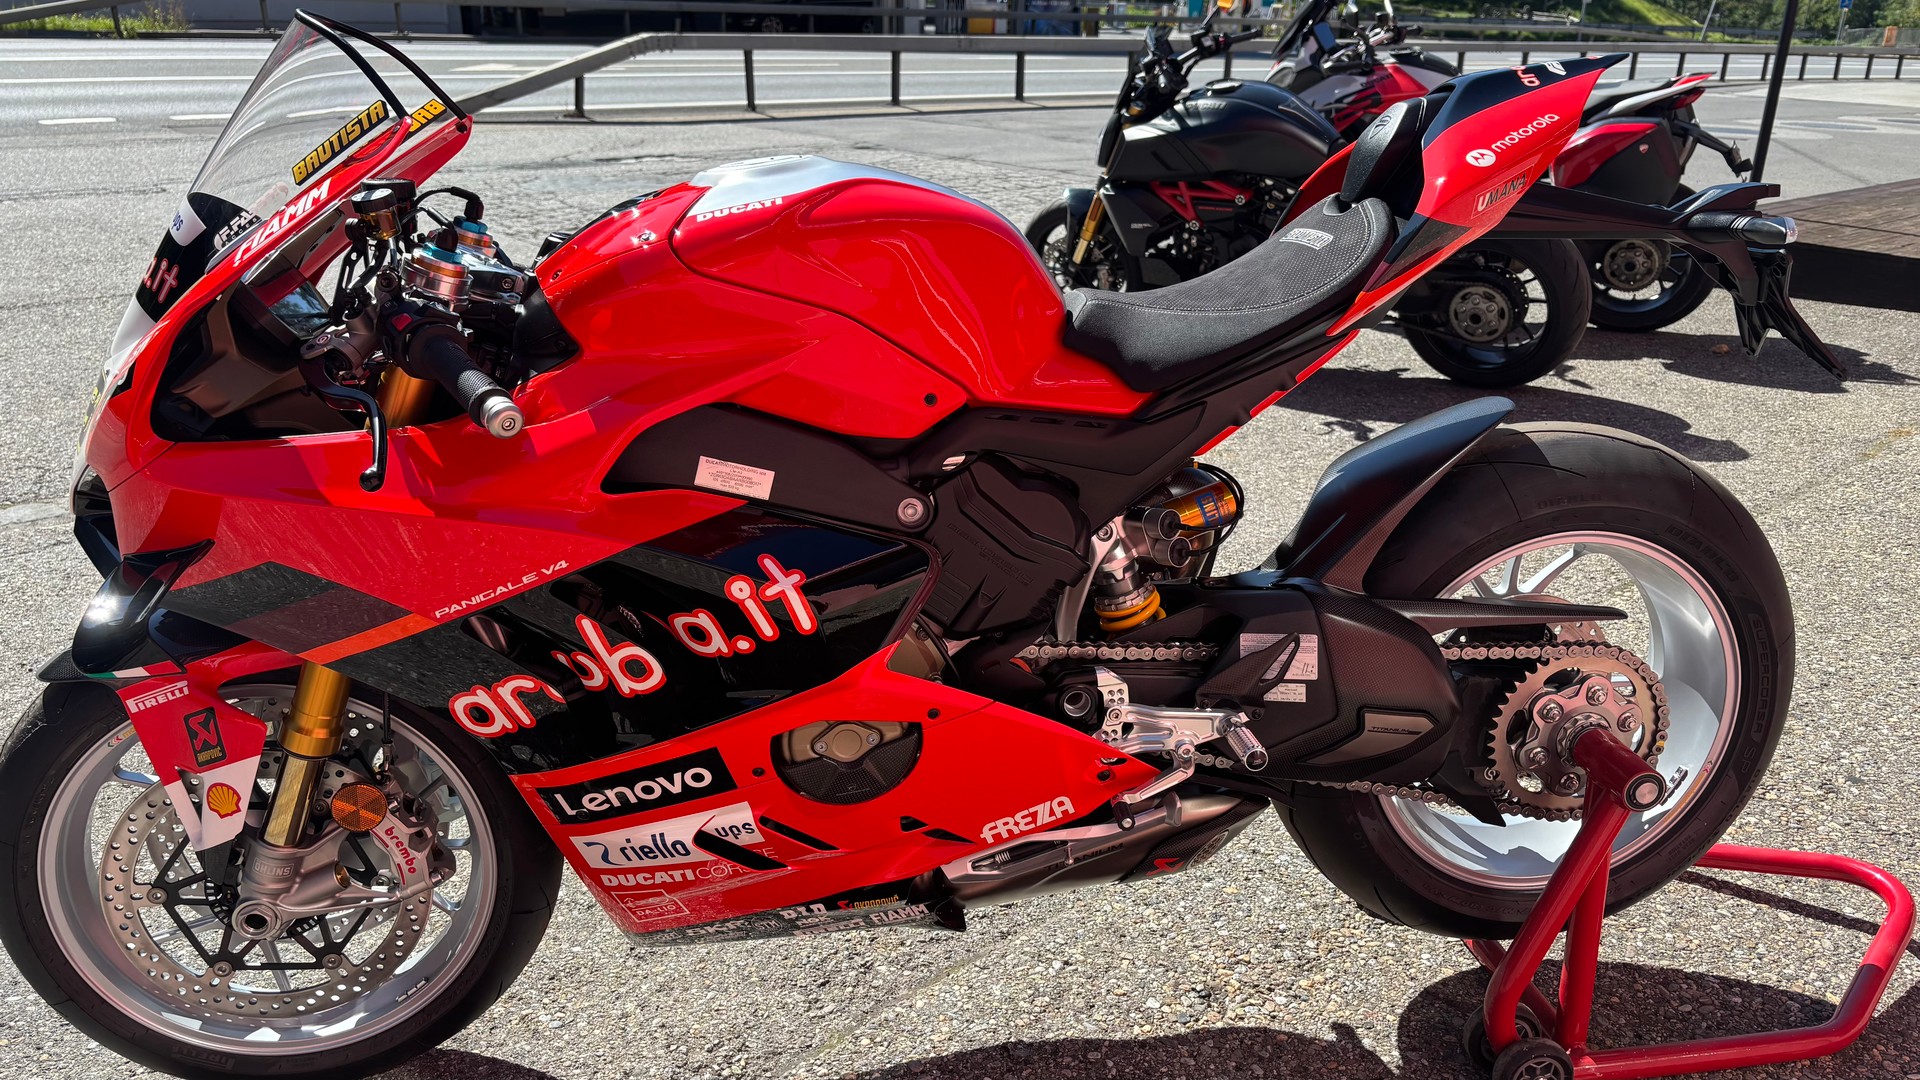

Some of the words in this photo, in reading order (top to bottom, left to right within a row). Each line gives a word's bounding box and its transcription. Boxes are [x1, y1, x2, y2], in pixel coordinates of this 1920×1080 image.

[292, 100, 385, 184] BAUTISTA
[1491, 113, 1560, 152] motorola
[696, 196, 783, 223] DUCATI
[1477, 172, 1527, 212] UMANA
[233, 177, 332, 267] FIAMM
[434, 572, 539, 618] PANIGALE
[541, 559, 570, 577] V4
[125, 680, 189, 714] PIRELLI
[1751, 616, 1772, 734] SUPERCORSA
[554, 767, 713, 816] Lenovo
[619, 832, 692, 862] riello
[715, 821, 756, 840] ups
[980, 796, 1075, 844] FREZZA
[384, 826, 417, 875] brembo
[599, 868, 695, 887] DUCATI
[869, 904, 930, 922] FIAMM
